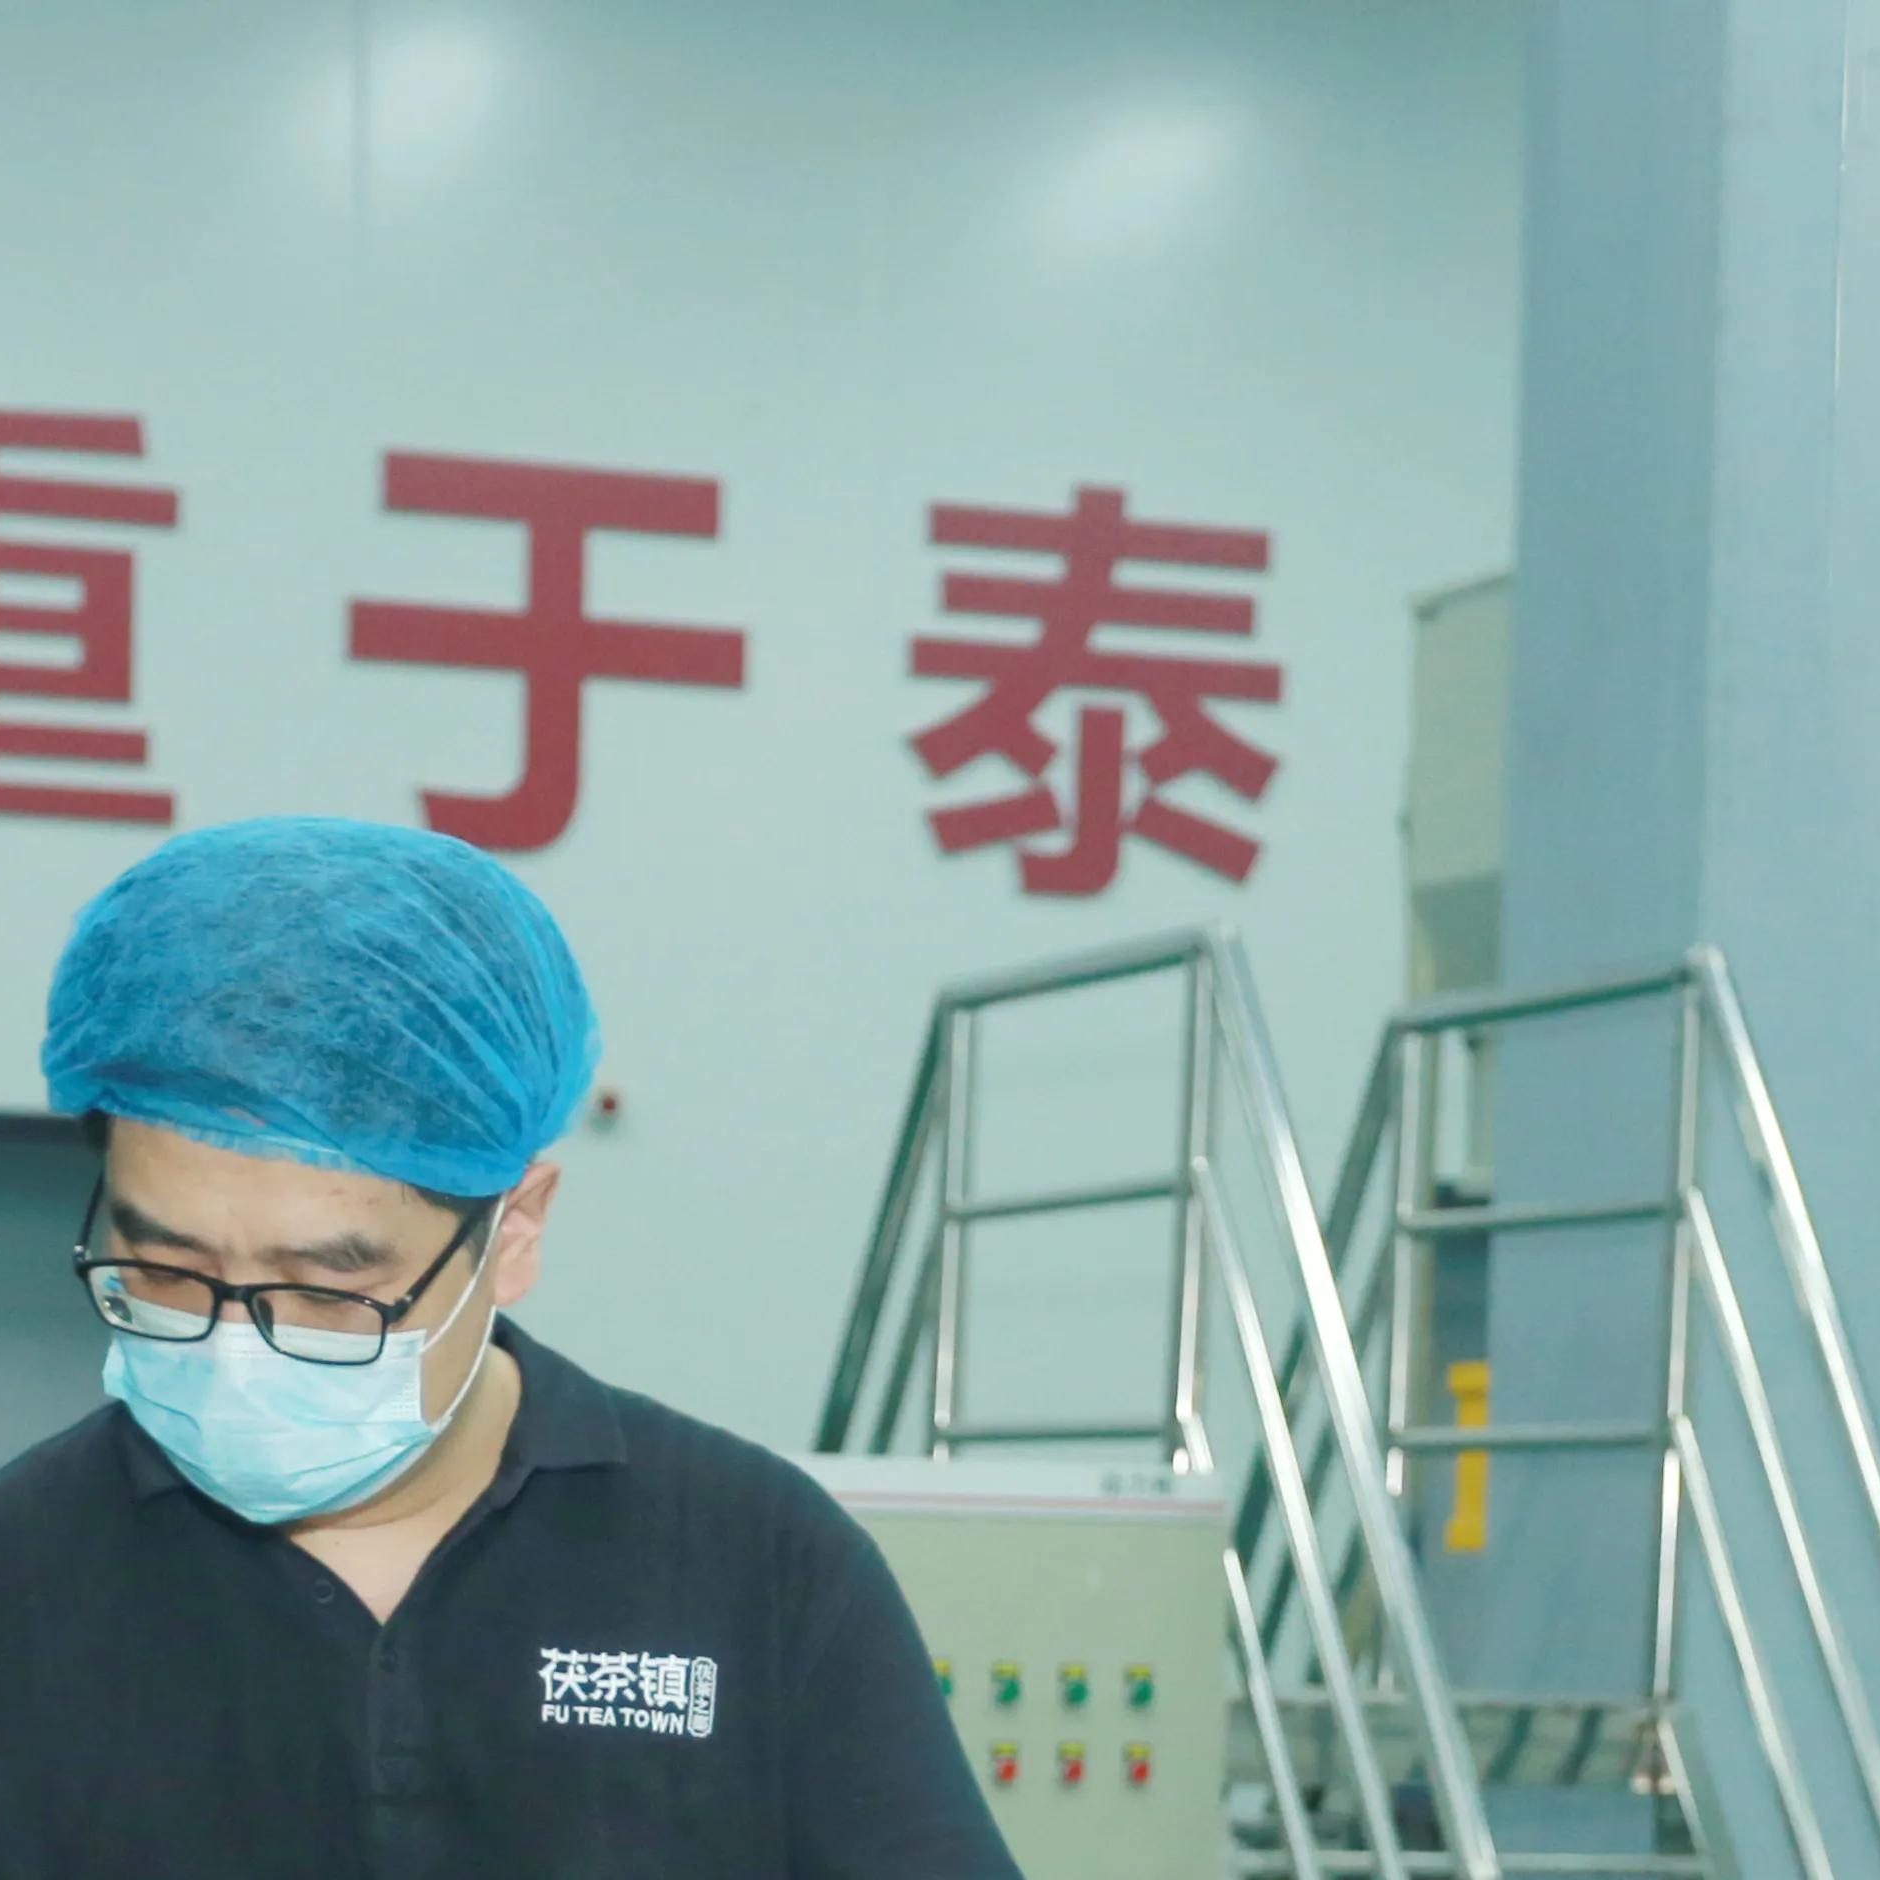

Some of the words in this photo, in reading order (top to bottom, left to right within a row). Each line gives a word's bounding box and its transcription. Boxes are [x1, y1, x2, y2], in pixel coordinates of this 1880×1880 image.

[538, 1647, 691, 1711] 茯茶镇
[541, 1704, 570, 1725] FU
[572, 1706, 617, 1728] TEA
[617, 1707, 685, 1736] TOWN
